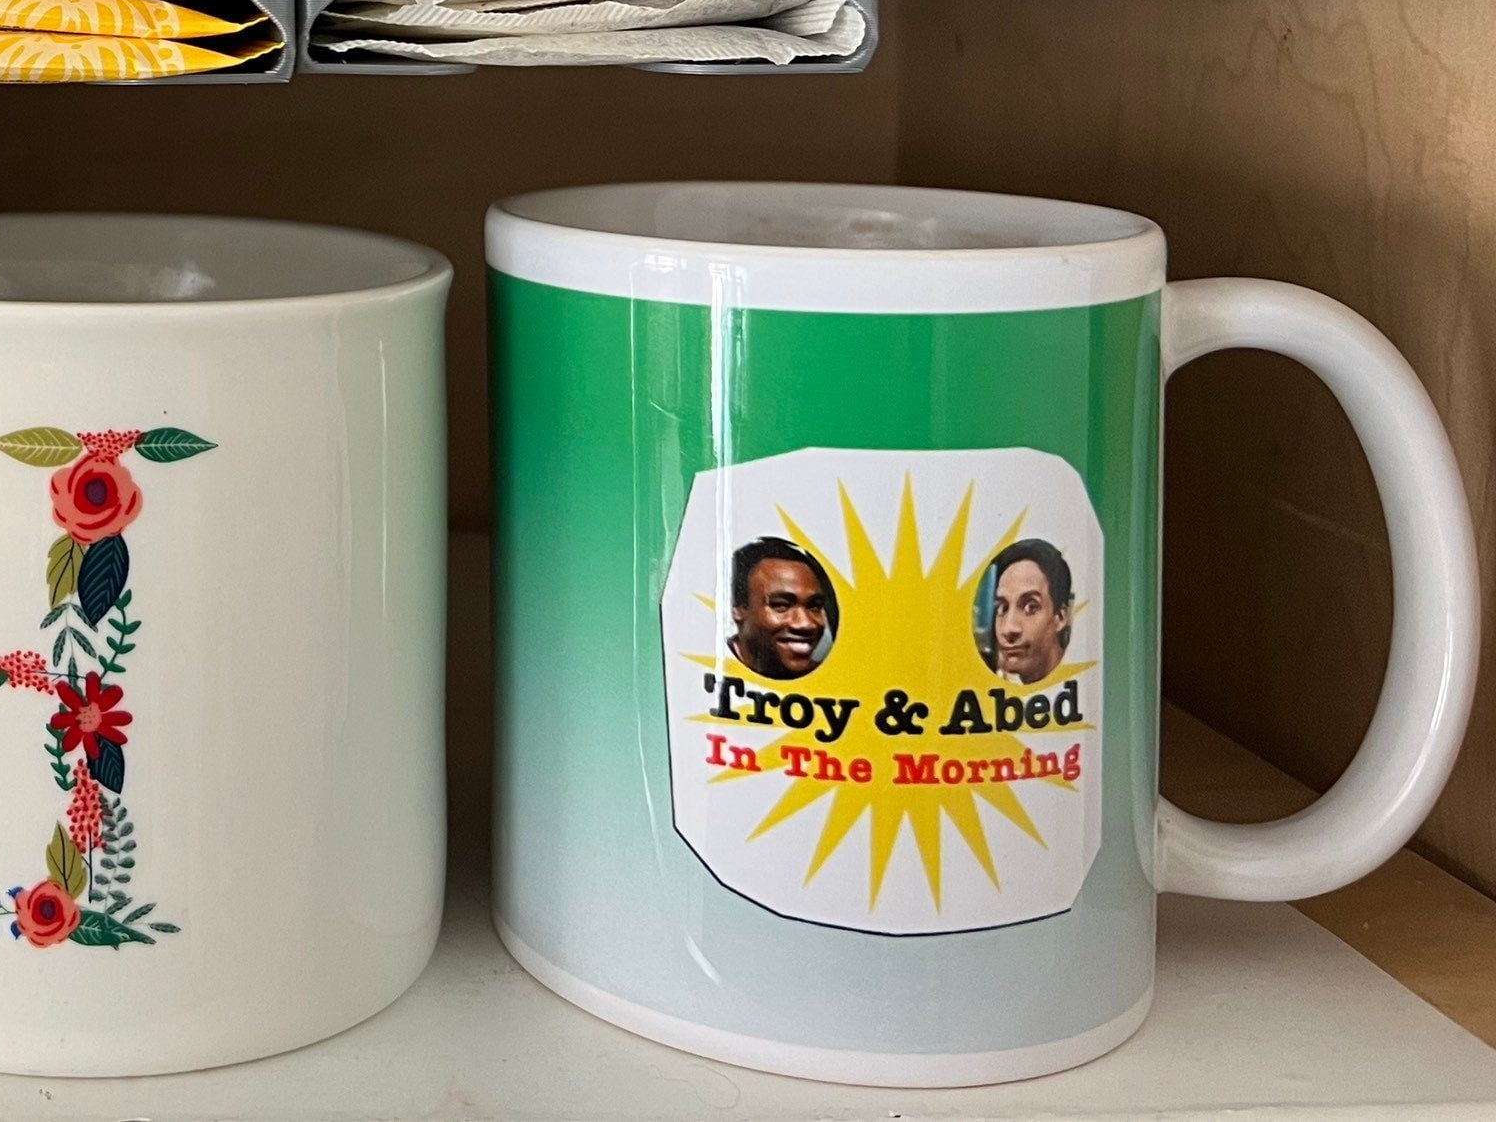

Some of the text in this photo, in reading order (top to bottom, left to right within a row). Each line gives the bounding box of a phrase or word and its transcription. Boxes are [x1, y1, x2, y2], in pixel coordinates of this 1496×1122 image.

[704, 673, 1082, 743] Troy & Abed
[706, 733, 1081, 785] In The Morning
